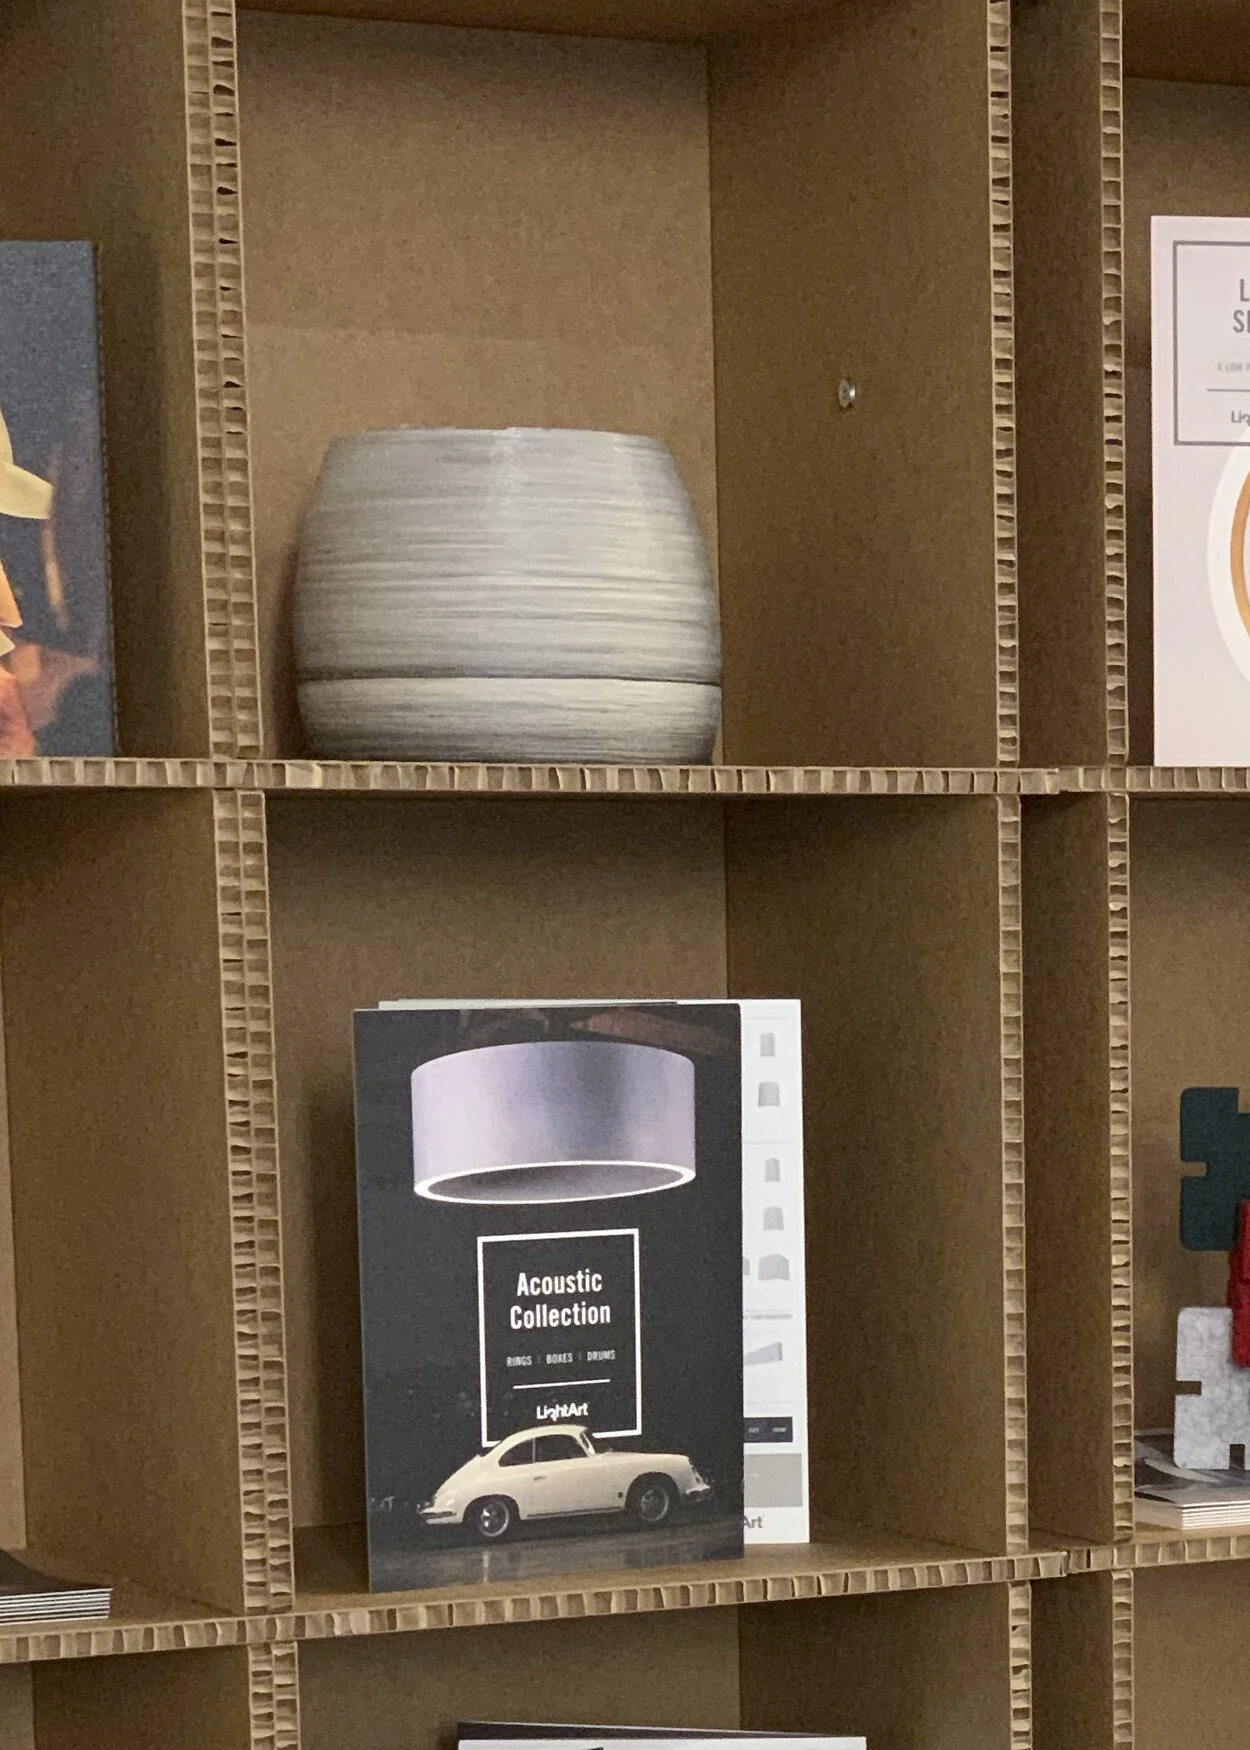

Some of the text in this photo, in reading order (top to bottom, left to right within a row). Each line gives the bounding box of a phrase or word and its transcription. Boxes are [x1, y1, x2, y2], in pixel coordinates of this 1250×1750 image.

[516, 1268, 603, 1297] Acoustic
[510, 1301, 612, 1330] Collection
[506, 1350, 616, 1367] RINGS BOXES DRUMS
[536, 1403, 589, 1421] LightArt
